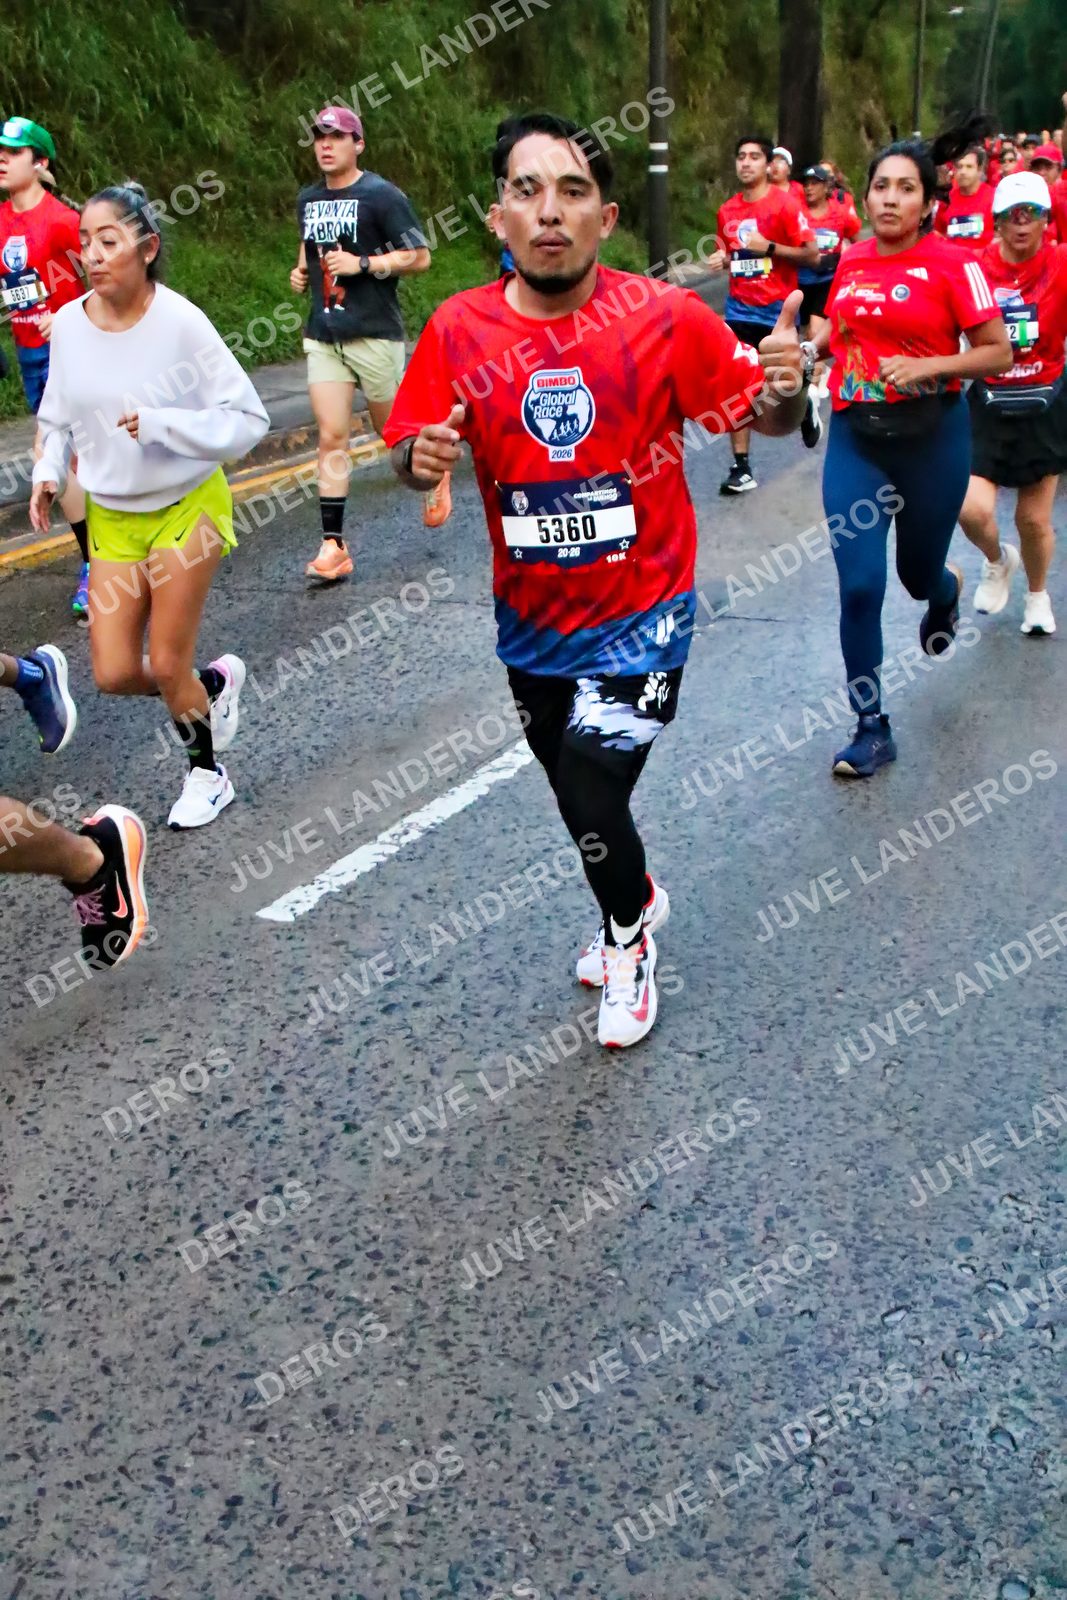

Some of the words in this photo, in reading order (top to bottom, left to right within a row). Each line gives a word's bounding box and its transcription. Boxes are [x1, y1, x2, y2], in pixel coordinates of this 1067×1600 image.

[10, 286, 31, 302] 5637
[537, 376, 576, 388] BIMBO
[539, 391, 576, 406] Global
[533, 405, 563, 419] Race
[551, 449, 572, 459] 2026
[536, 513, 597, 544] 5360
[606, 552, 627, 563] 10K
